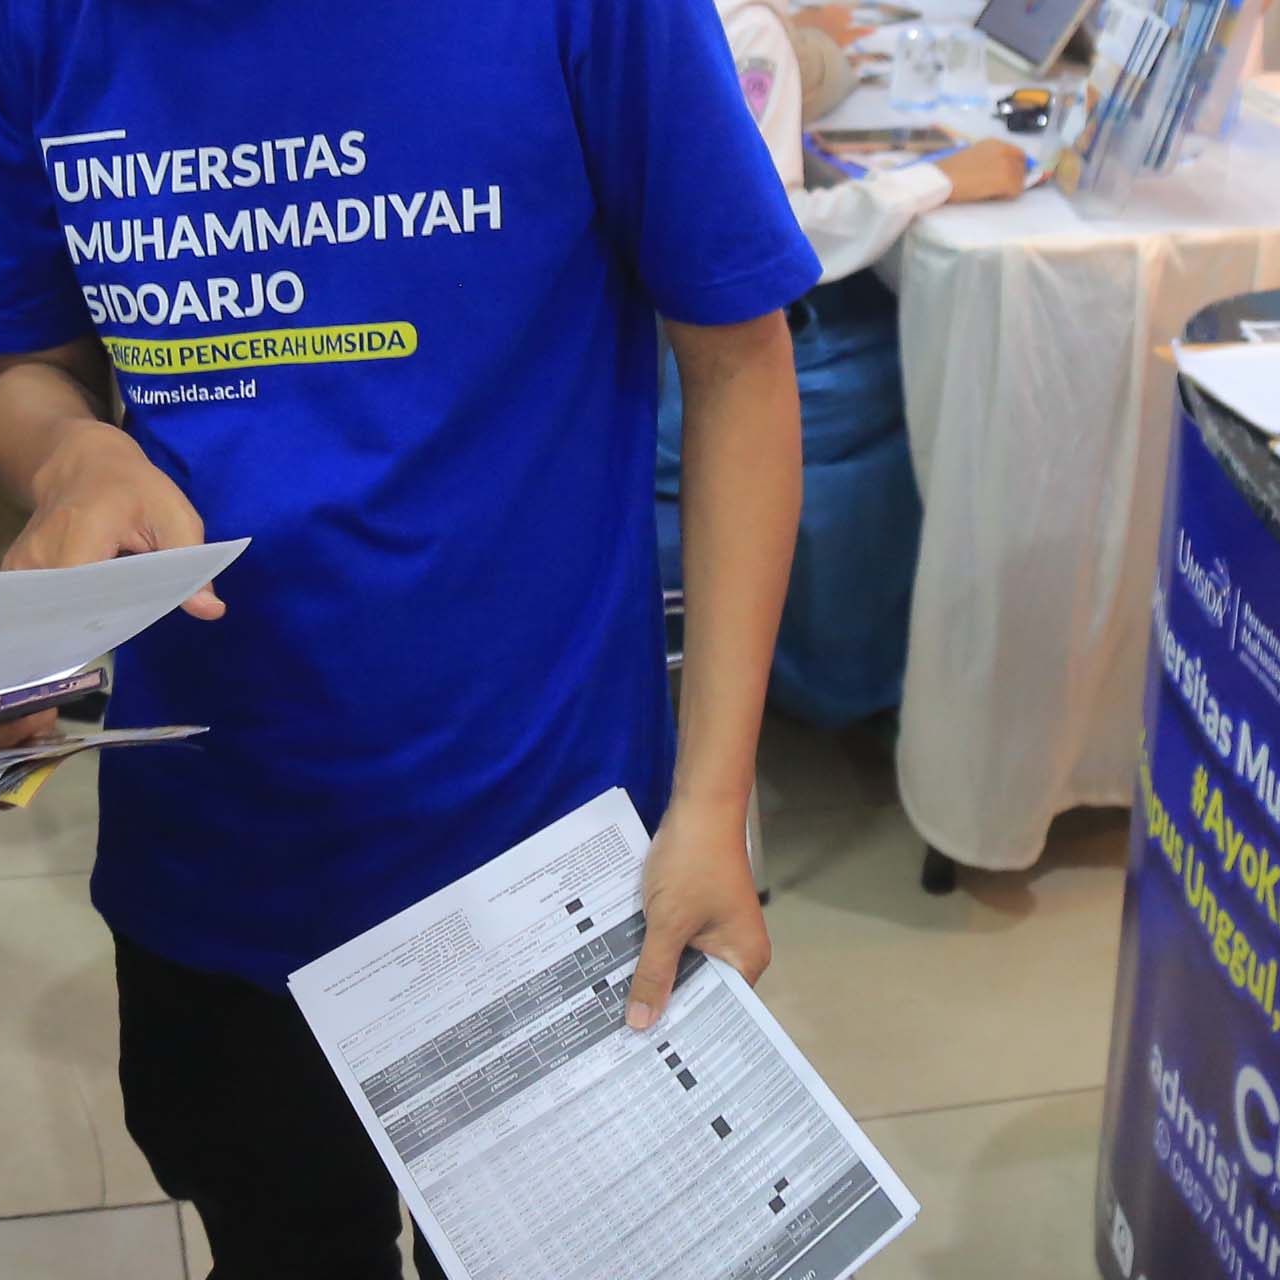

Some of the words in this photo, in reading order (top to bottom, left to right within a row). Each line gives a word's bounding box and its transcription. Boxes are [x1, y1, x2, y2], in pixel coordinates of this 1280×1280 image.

[54, 130, 367, 203] UNIVERSITAS
[64, 185, 502, 265] MUHAMMADIYAH
[82, 270, 305, 326] SIDOARJO
[107, 343, 173, 368] NERASI
[179, 335, 307, 367] PENCERAH
[311, 329, 407, 356] UMSIDA
